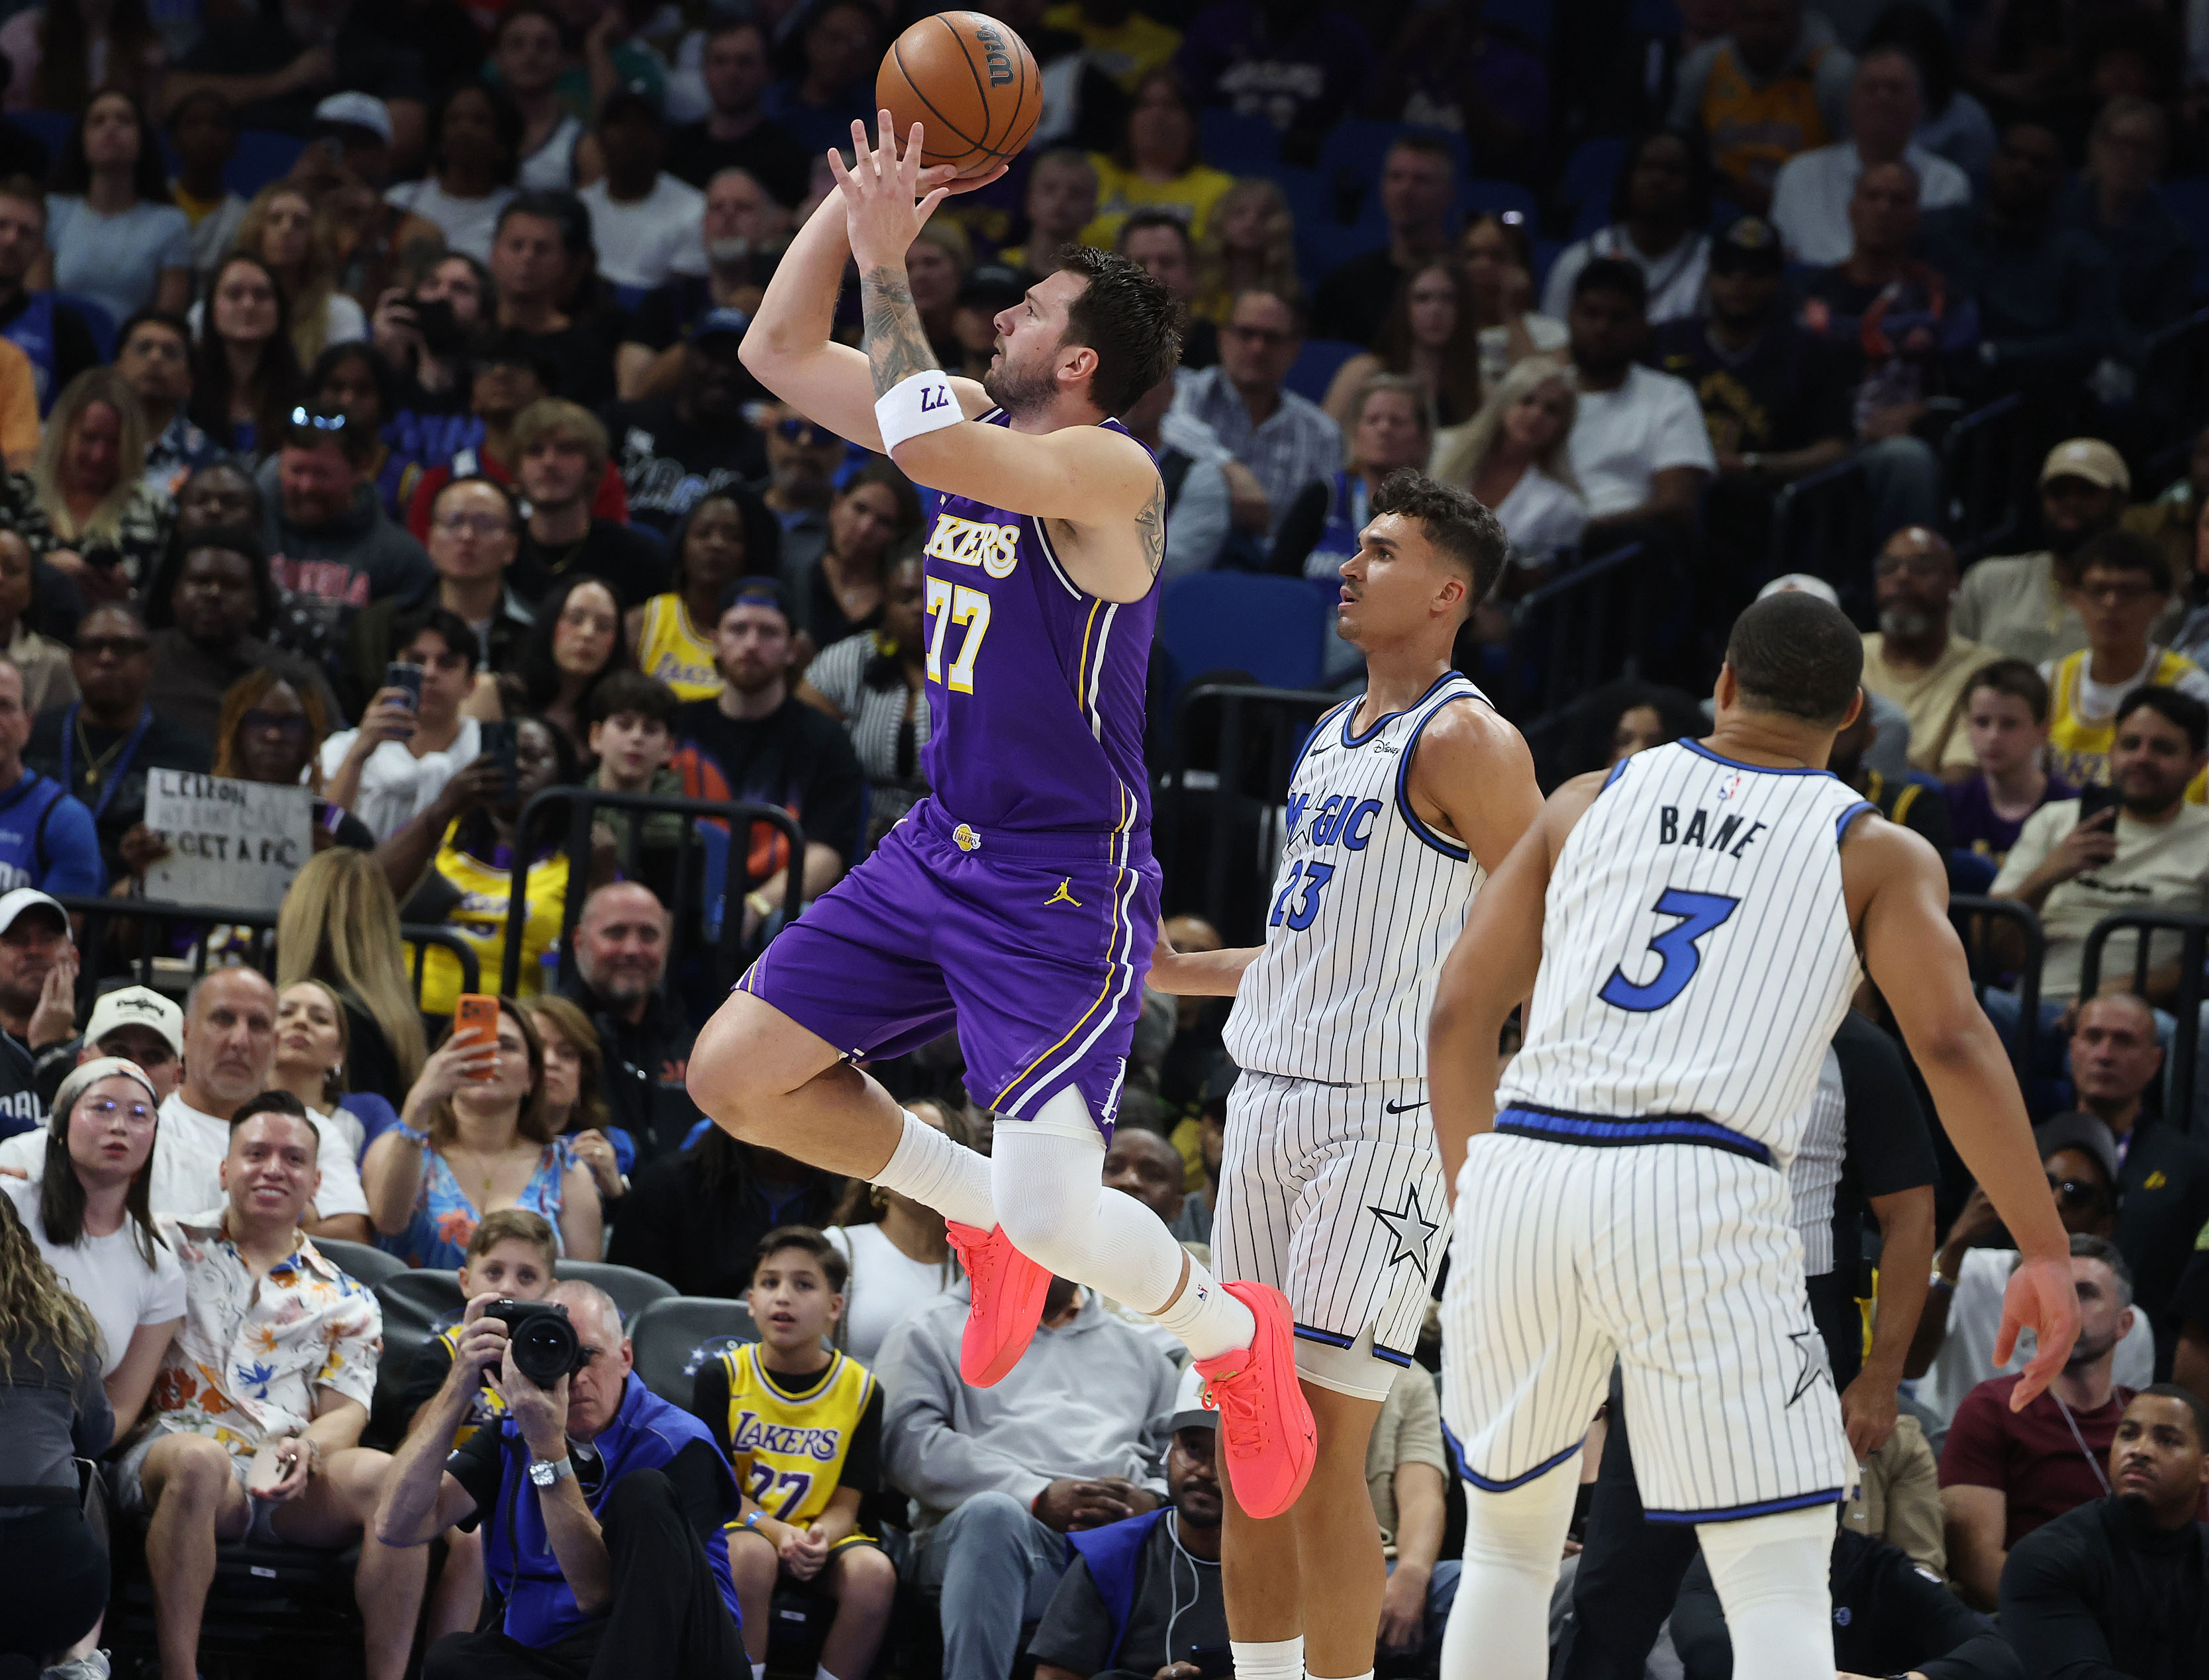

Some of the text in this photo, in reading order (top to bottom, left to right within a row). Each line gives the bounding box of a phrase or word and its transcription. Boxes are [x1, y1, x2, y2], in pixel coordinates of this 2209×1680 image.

[923, 513, 1020, 579] KERS
[926, 575, 991, 695] 77
[1660, 806, 1767, 859] BANE
[1269, 860, 1336, 931] 23
[1597, 886, 1742, 1013] 3
[732, 1411, 842, 1463] LAKERS
[750, 1459, 814, 1522] 77
